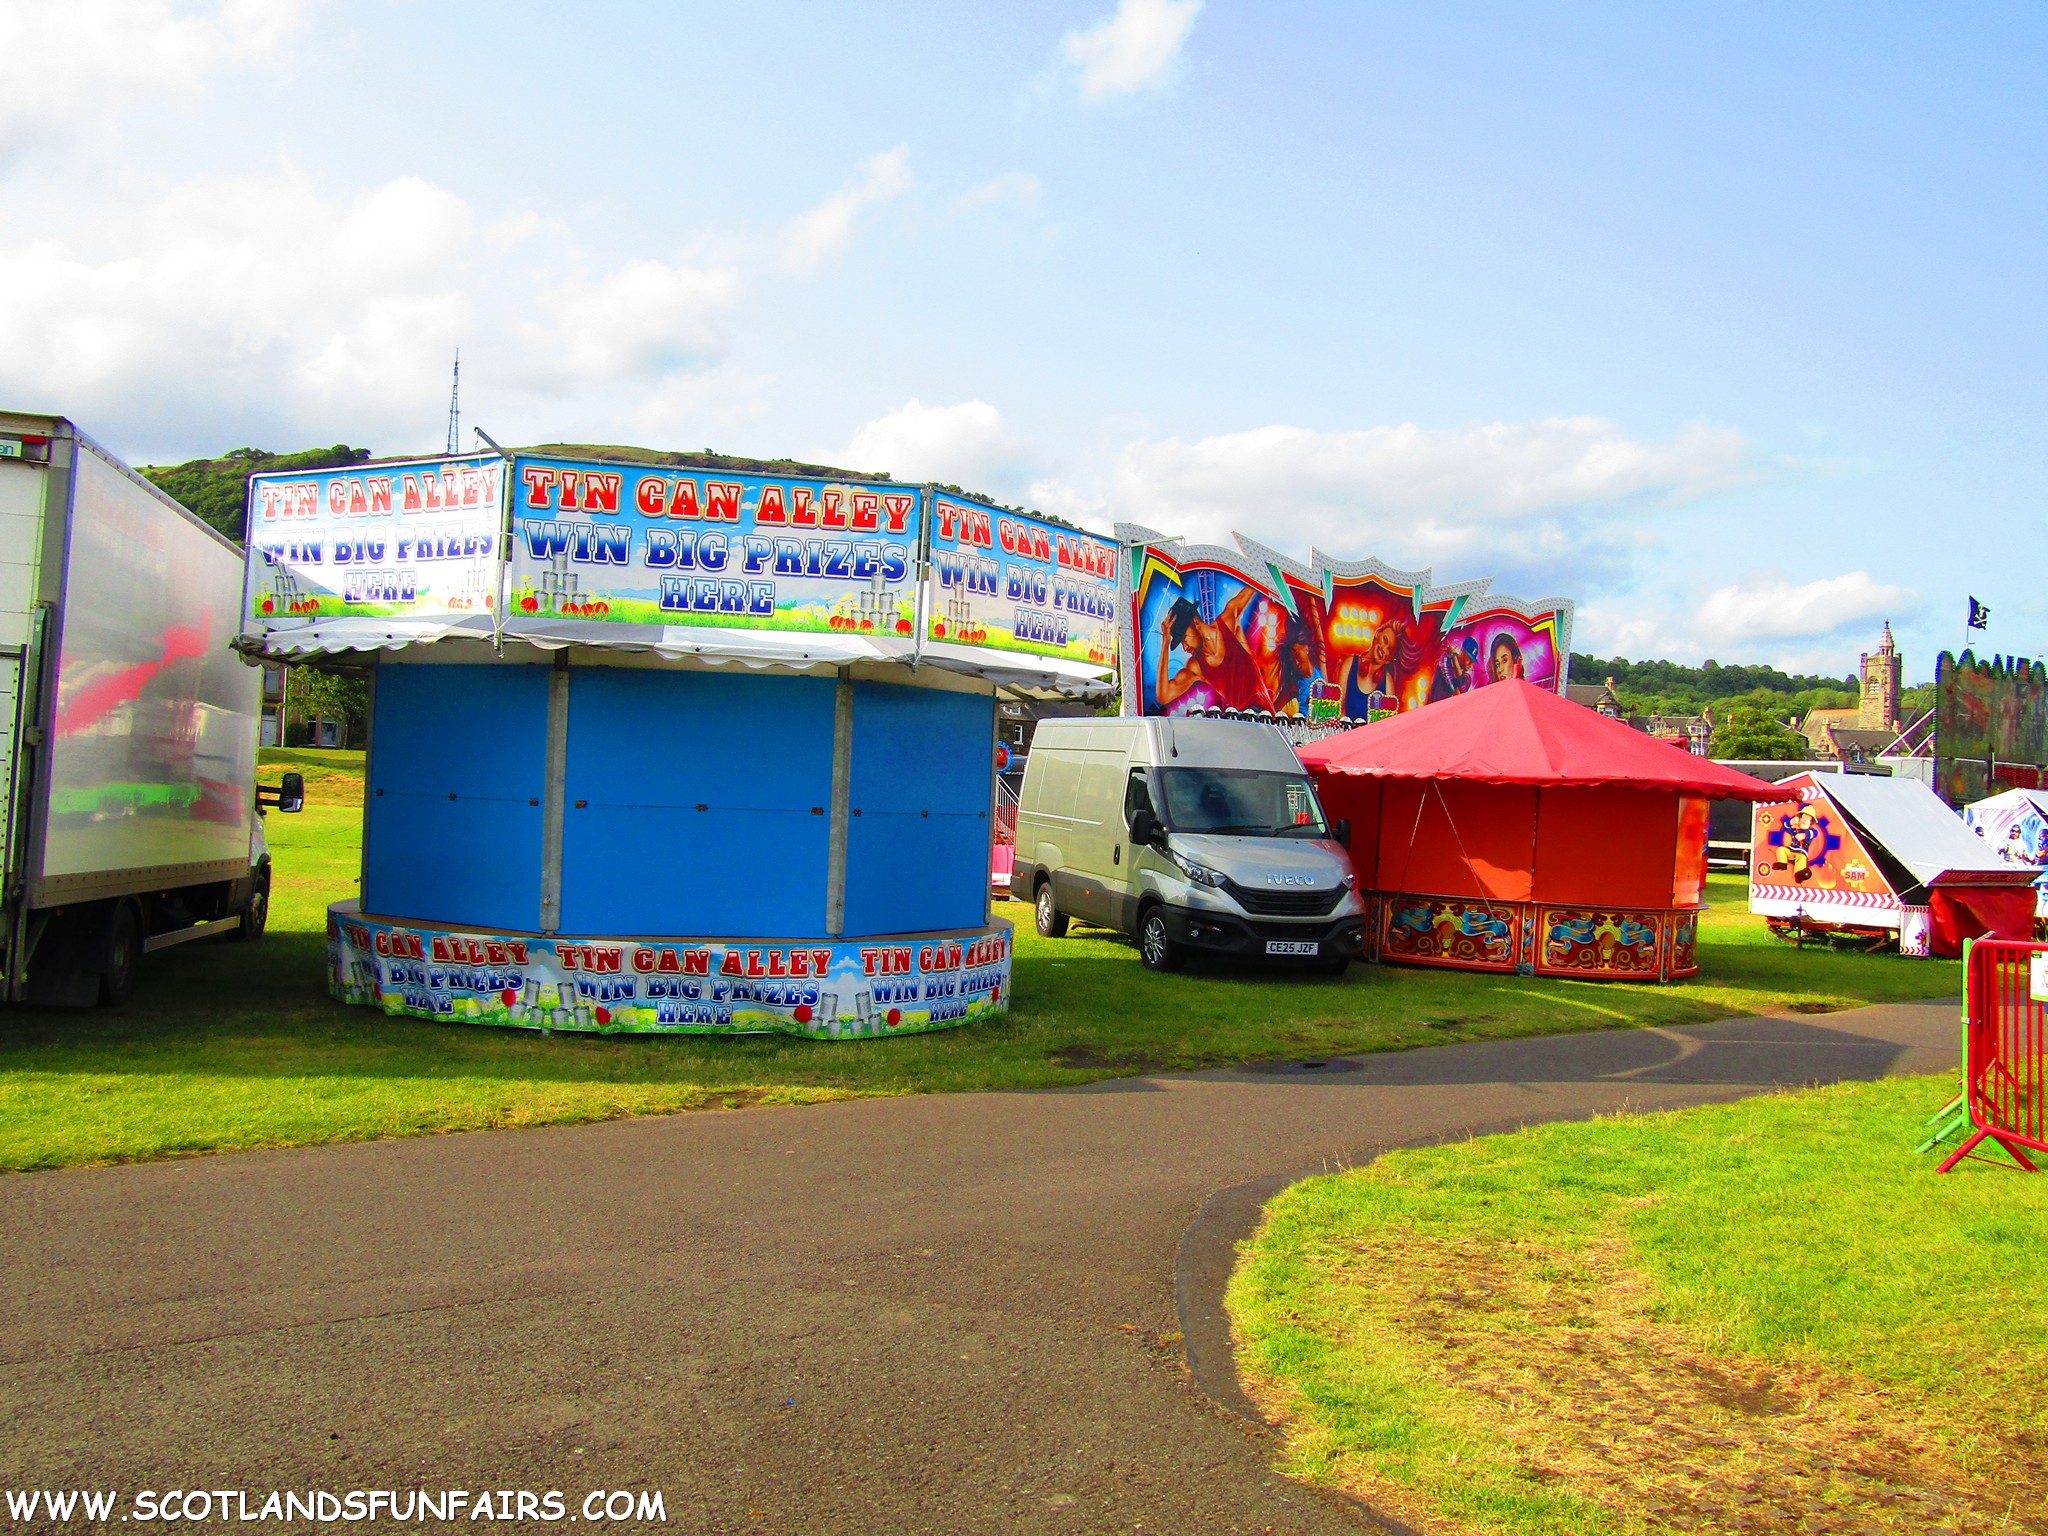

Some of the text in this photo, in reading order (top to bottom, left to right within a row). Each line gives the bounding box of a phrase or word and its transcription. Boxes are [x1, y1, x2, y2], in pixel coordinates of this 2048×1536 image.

[260, 466, 499, 521] TIN CAN ALLEY
[522, 465, 915, 533] TIN CAN ALLEY
[259, 517, 496, 566] WIN BIG PRIZES
[523, 519, 908, 582] WIN BIG PRIZES
[936, 500, 1117, 581] TIN CAN ALLEY
[343, 569, 418, 604] HERE
[660, 574, 775, 616] HERE
[937, 550, 1115, 623] WIN BIG PRIZES
[1014, 606, 1068, 647] HERE
[1267, 874, 1315, 886] IVECO
[1845, 871, 1865, 880] SAM
[375, 930, 424, 960] CAN
[432, 936, 529, 967] ALLEY
[555, 945, 832, 977] TIN CAN ALLEY
[860, 946, 912, 976] TIN
[919, 943, 962, 973] CAN
[964, 936, 1006, 969] ALLEY
[1270, 943, 1315, 953] CE25 JZF
[388, 958, 425, 986] BIG
[427, 963, 524, 992] PRIZES
[574, 972, 821, 1007] WIN BIG PRIZES
[871, 966, 1002, 1003] WIN BIG PRIZES
[656, 1000, 733, 1026] HERE
[930, 999, 968, 1024] HERE
